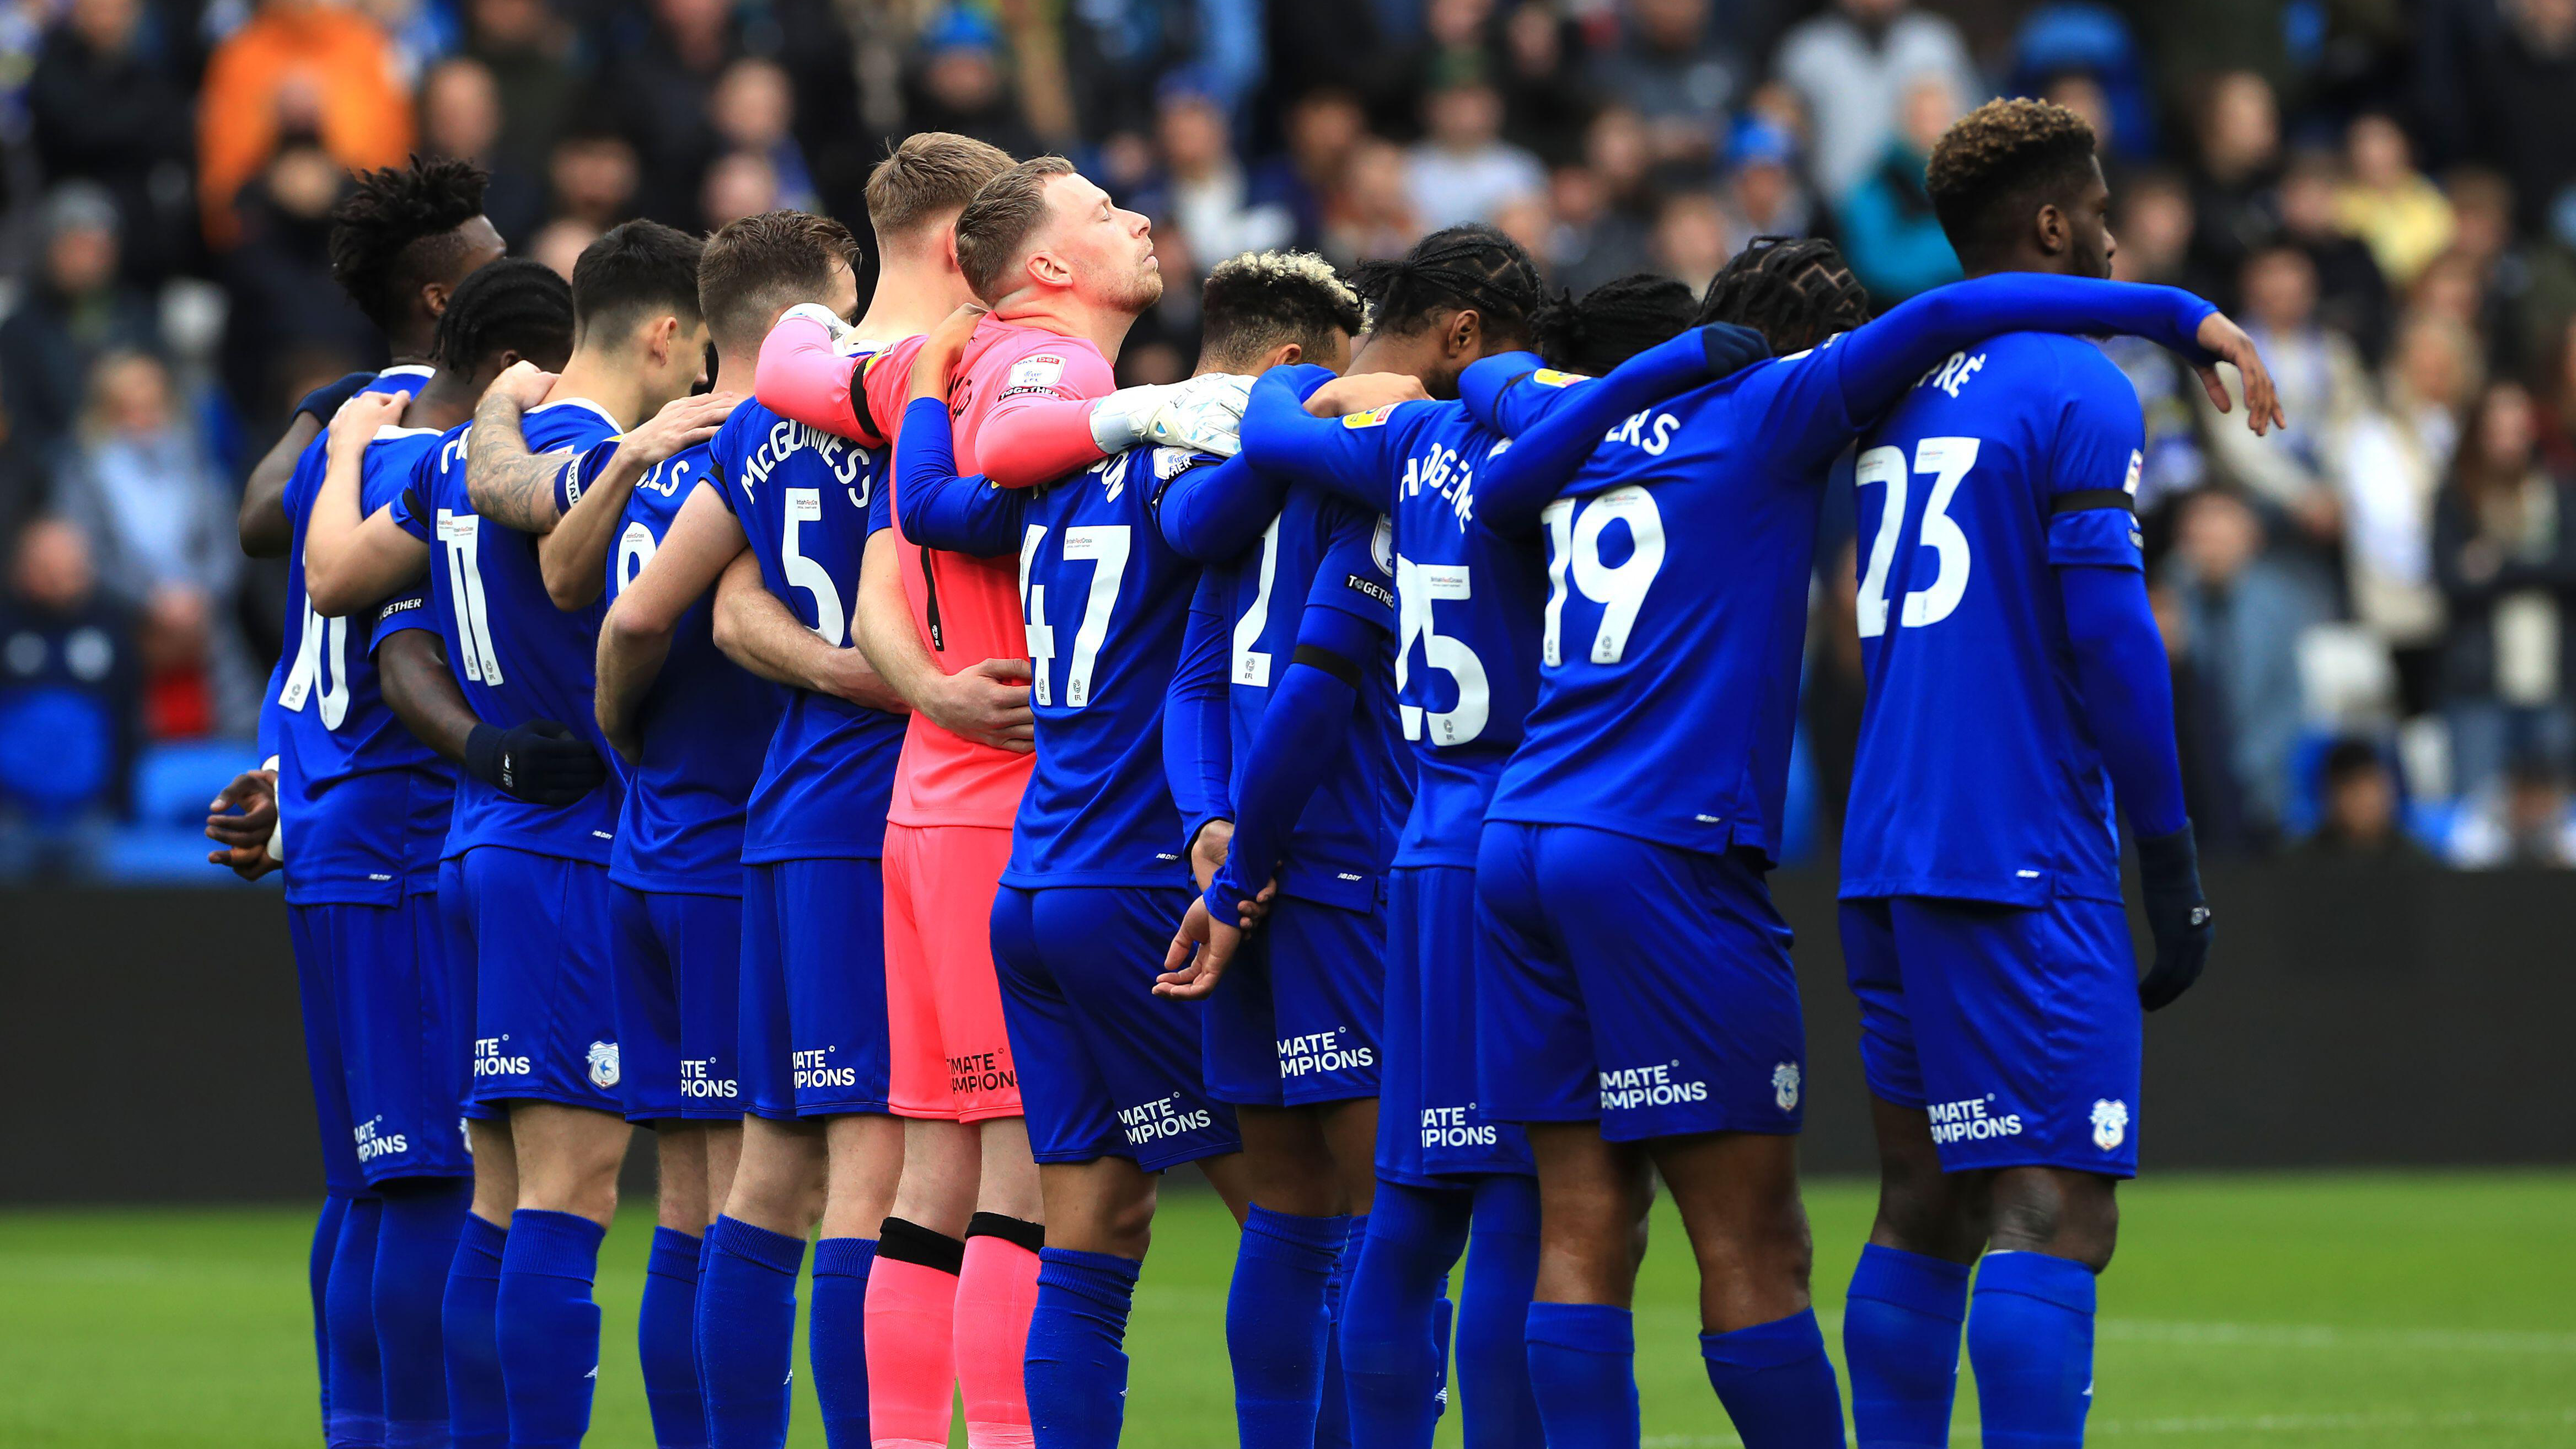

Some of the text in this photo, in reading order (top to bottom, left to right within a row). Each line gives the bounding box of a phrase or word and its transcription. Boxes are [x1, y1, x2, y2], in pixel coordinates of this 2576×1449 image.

[379, 598, 421, 621] GETHER
[437, 508, 504, 686] 11
[782, 488, 845, 648] 5
[1019, 524, 1131, 707] 47
[1348, 575, 1394, 608] TOGETHE
[1543, 486, 1666, 666] 19
